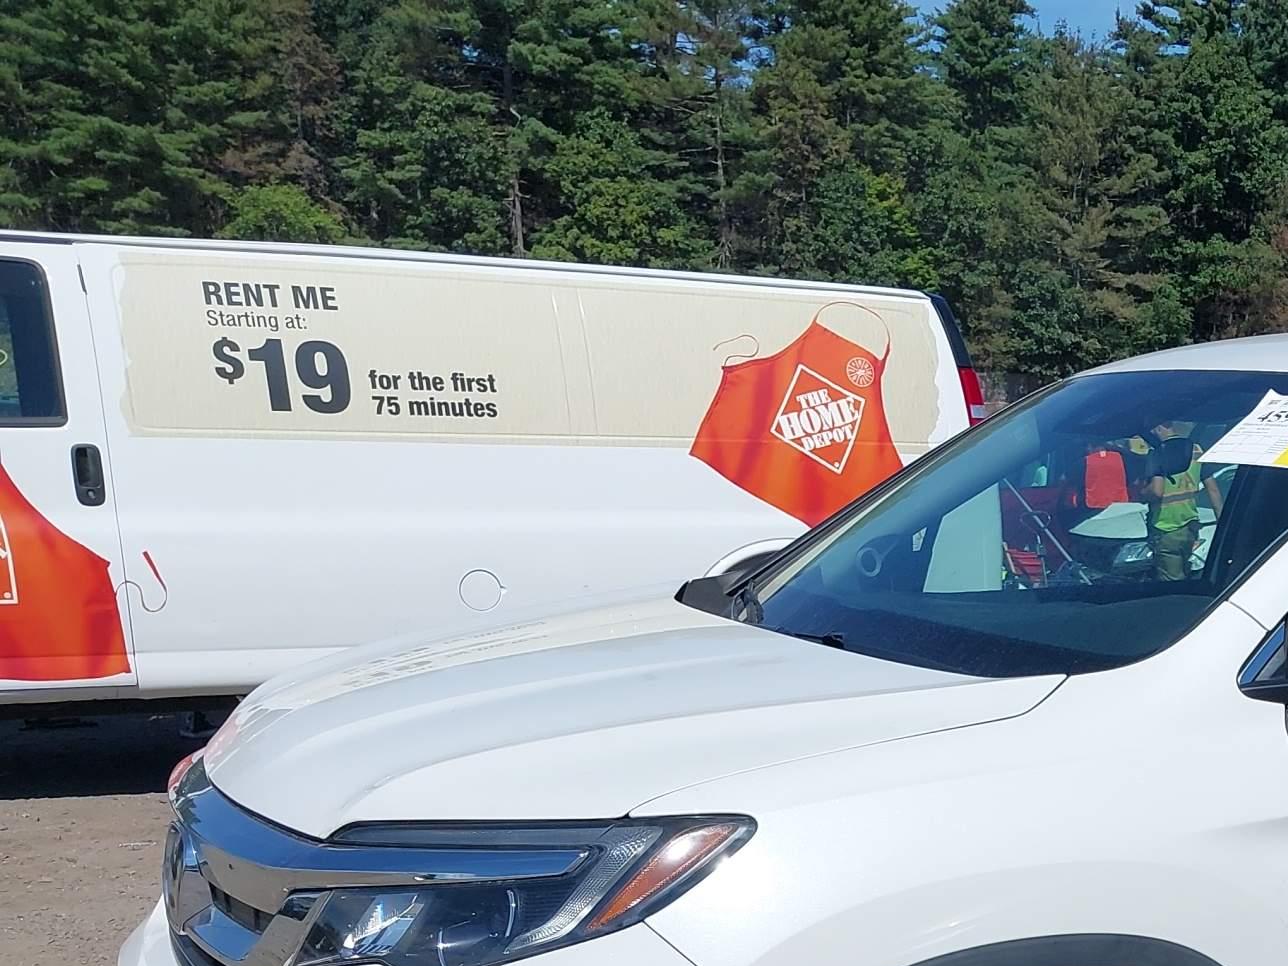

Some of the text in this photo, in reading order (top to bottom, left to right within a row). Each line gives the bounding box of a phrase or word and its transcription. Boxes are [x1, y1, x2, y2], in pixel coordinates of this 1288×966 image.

[202, 281, 338, 310] RENT ME
[207, 310, 307, 332] Starting at:
[213, 337, 351, 413] $19
[368, 370, 497, 393] for the first
[372, 396, 498, 418] 75 minutes
[796, 388, 831, 409] THE
[777, 398, 860, 440] HOME
[801, 425, 854, 451] DEPOT
